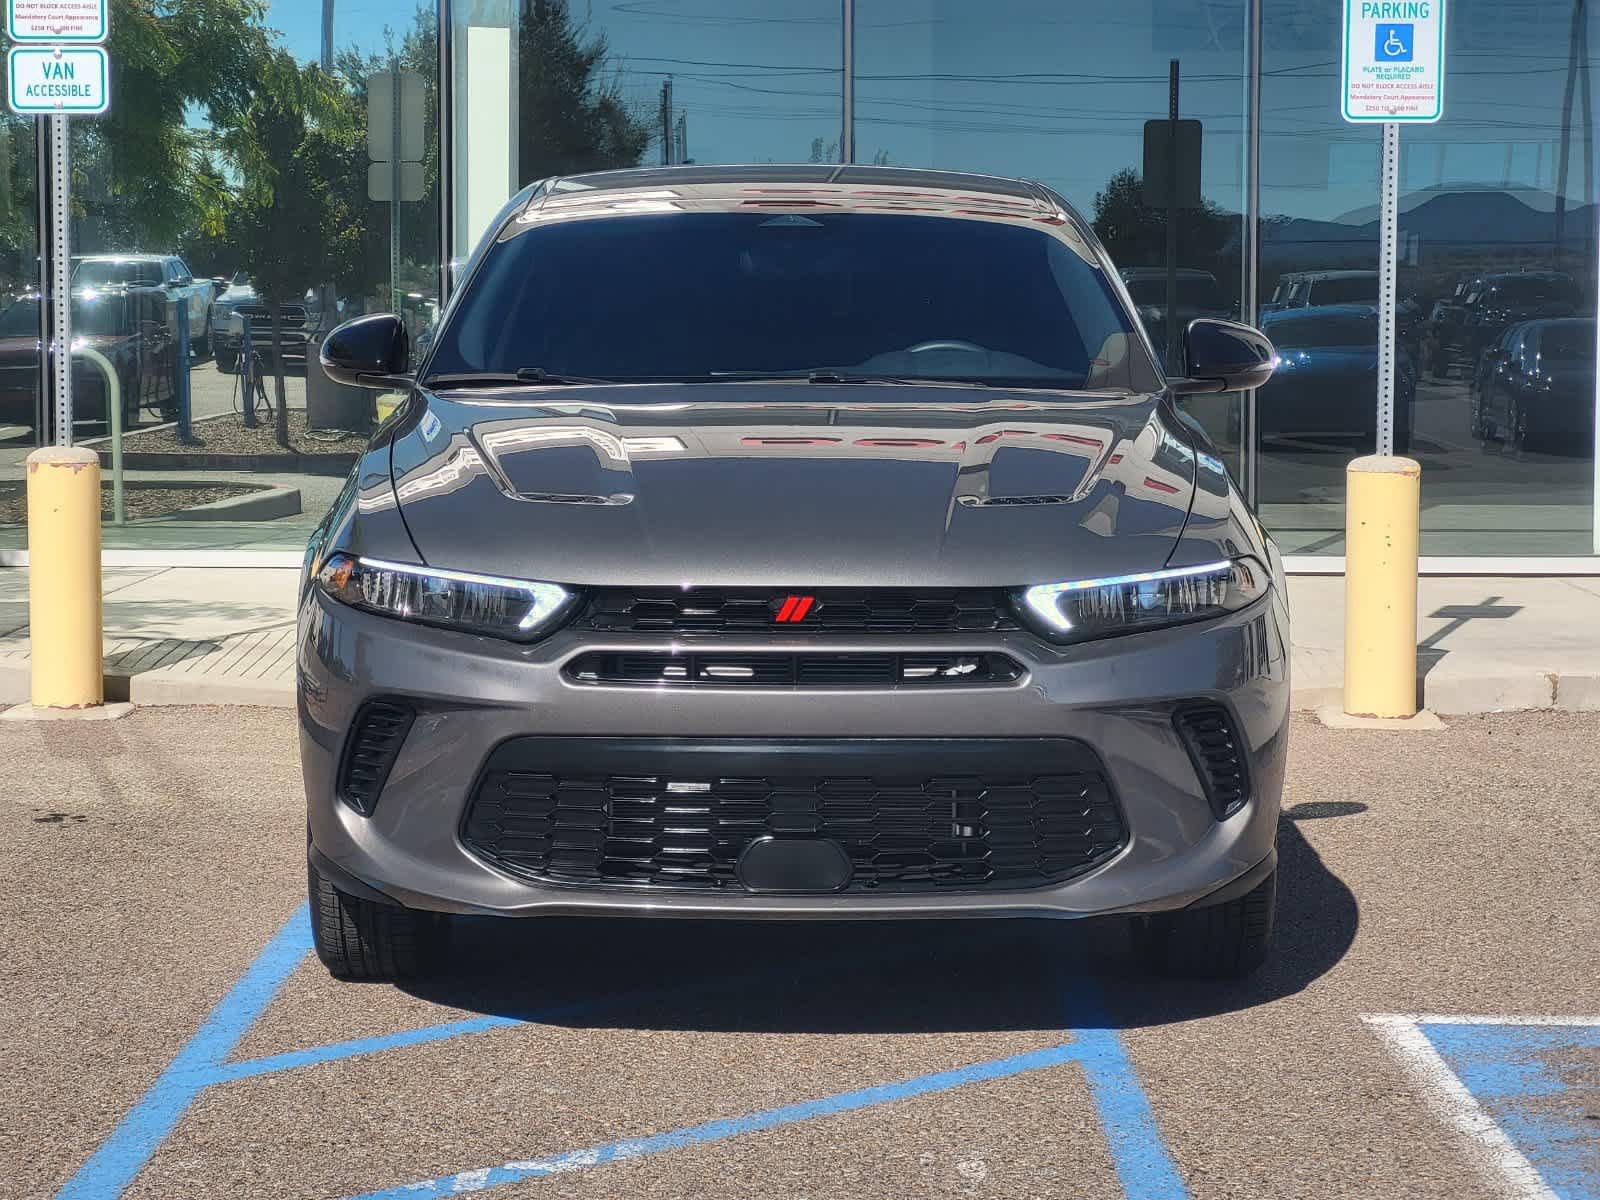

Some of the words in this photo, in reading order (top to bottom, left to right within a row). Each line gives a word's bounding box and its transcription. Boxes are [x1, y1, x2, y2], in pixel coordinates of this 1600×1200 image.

[1362, 2, 1429, 19] PARKING
[42, 62, 74, 80] VAN
[26, 84, 91, 96] ACCESSIBLE
